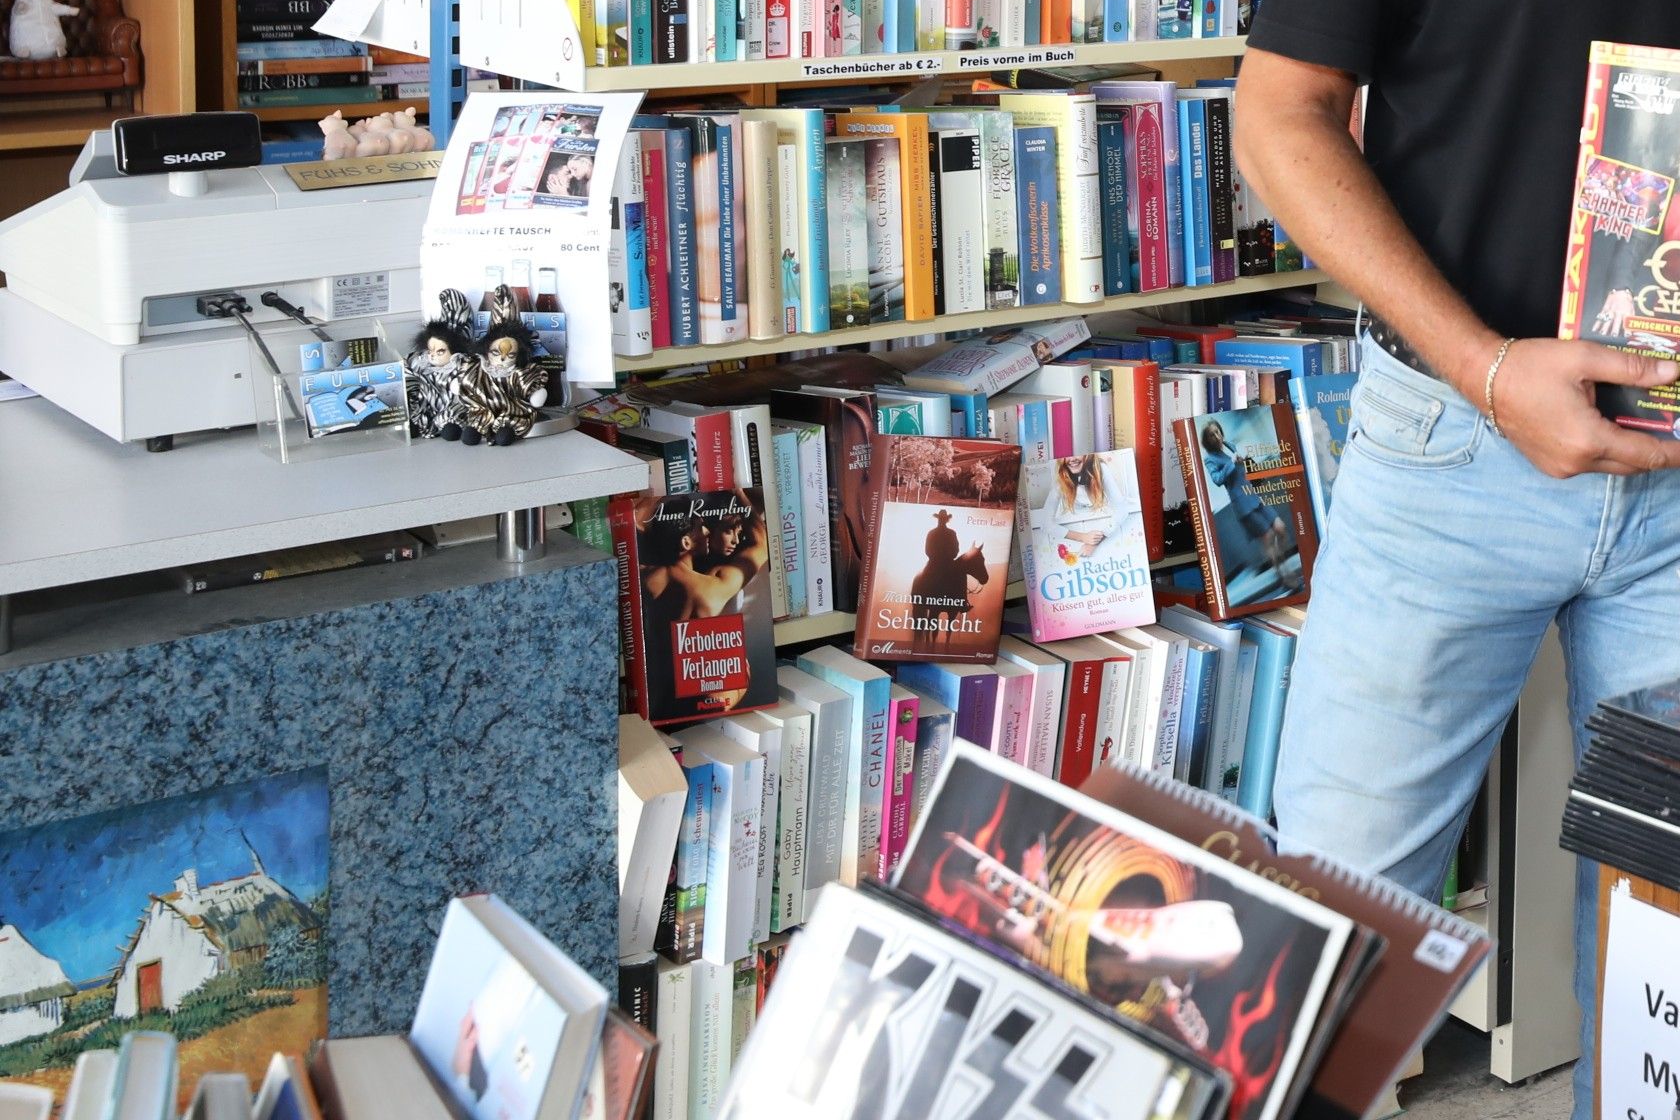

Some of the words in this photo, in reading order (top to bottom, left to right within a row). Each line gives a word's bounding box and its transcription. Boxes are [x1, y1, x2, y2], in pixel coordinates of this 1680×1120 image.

[668, 15, 677, 59] ullstein
[804, 60, 898, 75] Taschenbücher
[899, 60, 913, 70] ab
[916, 60, 924, 70] €
[960, 56, 990, 67] Preis
[992, 55, 1025, 66] vorne
[1028, 53, 1042, 63] im
[1045, 50, 1074, 62] Buch
[163, 150, 227, 165] SHARP
[971, 137, 981, 171] PIPER
[1000, 141, 1011, 194] GRACE
[676, 161, 688, 214] flüchtig
[876, 157, 888, 228] GUTSHAUS
[509, 227, 552, 236] TAUSCH
[1029, 181, 1038, 260] Wolkenfischerin
[1041, 199, 1051, 272] Aprikosenküsse
[1144, 200, 1154, 240] CORINA
[1151, 196, 1160, 241] BOMANN
[560, 244, 573, 252] 80
[576, 243, 601, 252] Cent
[679, 221, 690, 292] ACHLEITNER
[681, 298, 692, 340] HUBERT
[1628, 320, 1672, 333] ZWISCHEN
[1241, 476, 1302, 497] Wunderbare
[1259, 492, 1295, 508] Valerie
[643, 502, 686, 523] Anne
[686, 495, 753, 523] Rampling
[782, 511, 799, 574] PHILLIPS
[809, 529, 818, 560] NINA
[819, 521, 829, 566] GEORGE
[1082, 553, 1132, 577] Rachel
[1040, 565, 1149, 601] Gibson
[925, 595, 963, 608] meiner
[1052, 599, 1086, 613] Küssen
[1106, 593, 1128, 605] alles
[1129, 591, 1145, 603] gut
[676, 621, 744, 655] Verbotenes
[876, 608, 983, 634] Sehnsucht
[682, 656, 742, 681] Verlangen
[700, 679, 724, 692] Roman
[868, 706, 888, 789] CHANEL
[1074, 712, 1087, 755] Vollendung
[1160, 710, 1178, 768] Kinsella
[783, 828, 793, 862] Gaby
[791, 805, 804, 879] Hauptmann
